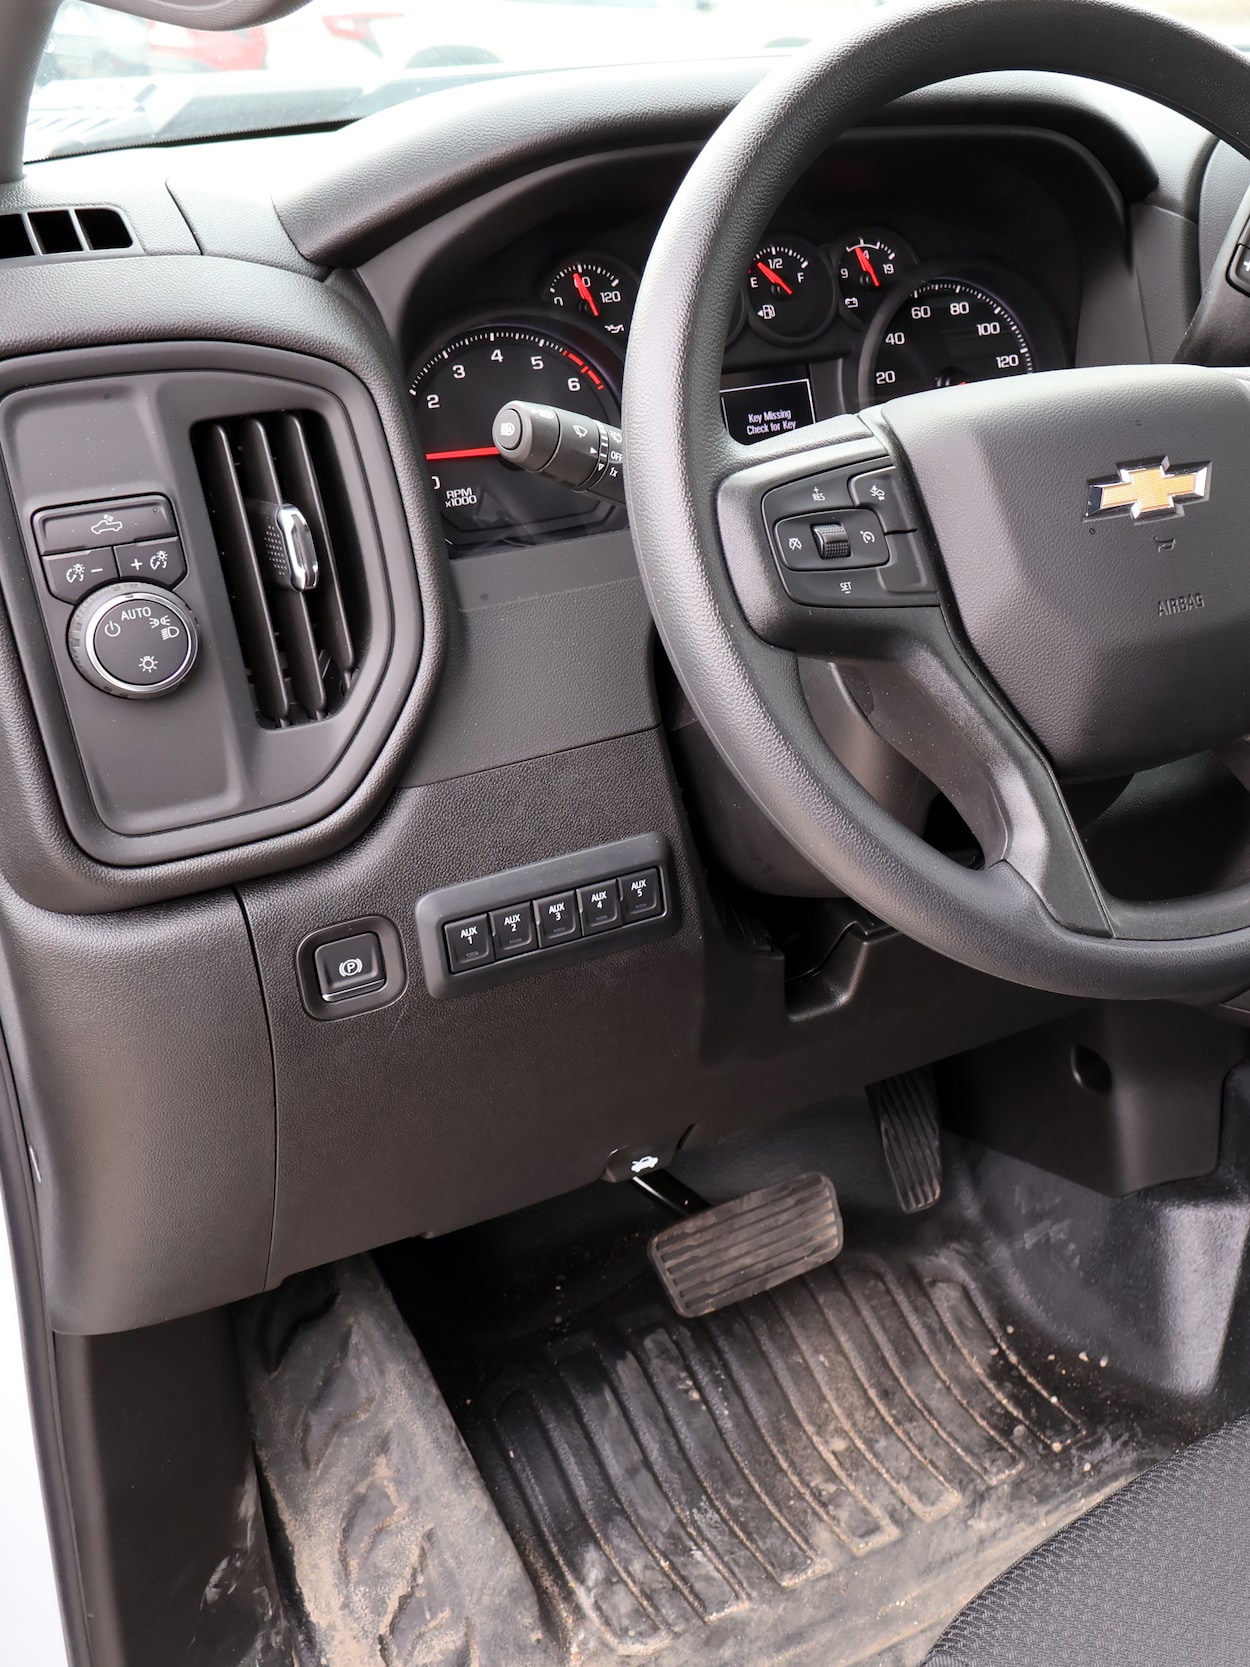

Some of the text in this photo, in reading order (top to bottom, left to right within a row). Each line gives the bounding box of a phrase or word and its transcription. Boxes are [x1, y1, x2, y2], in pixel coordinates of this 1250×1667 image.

[768, 258, 783, 270] 1/2
[882, 263, 895, 275] 19
[797, 272, 805, 284] F
[840, 267, 849, 279] 9
[750, 277, 758, 289] E
[600, 291, 621, 303] 120
[911, 305, 931, 320] 60
[950, 302, 970, 317] 80
[976, 322, 1000, 337] 100
[885, 332, 906, 346] 40
[490, 349, 503, 363] 4
[531, 356, 544, 370] 5
[996, 354, 1019, 369] 120
[452, 365, 465, 379] 3
[876, 371, 896, 385] 20
[567, 377, 580, 392] 6
[427, 395, 440, 409] 2
[748, 409, 791, 424] Key Missing
[746, 420, 796, 435] Check for Key
[610, 451, 623, 462] OFF
[609, 467, 618, 478] 1x
[446, 487, 473, 499] RPM
[812, 493, 826, 502] RES
[445, 494, 477, 508] x1000
[840, 582, 852, 592] SET
[1157, 592, 1205, 616] AIRBAG
[121, 606, 152, 621] AUTO
[630, 878, 648, 892] AUX
[590, 890, 608, 904] AUX
[636, 888, 644, 898] 5
[548, 902, 566, 916] AUX
[596, 899, 603, 909] 4
[504, 913, 522, 927] AUX
[555, 911, 562, 921] 3
[460, 926, 478, 940] AUX
[510, 922, 518, 932] 2
[467, 934, 474, 945] 1
